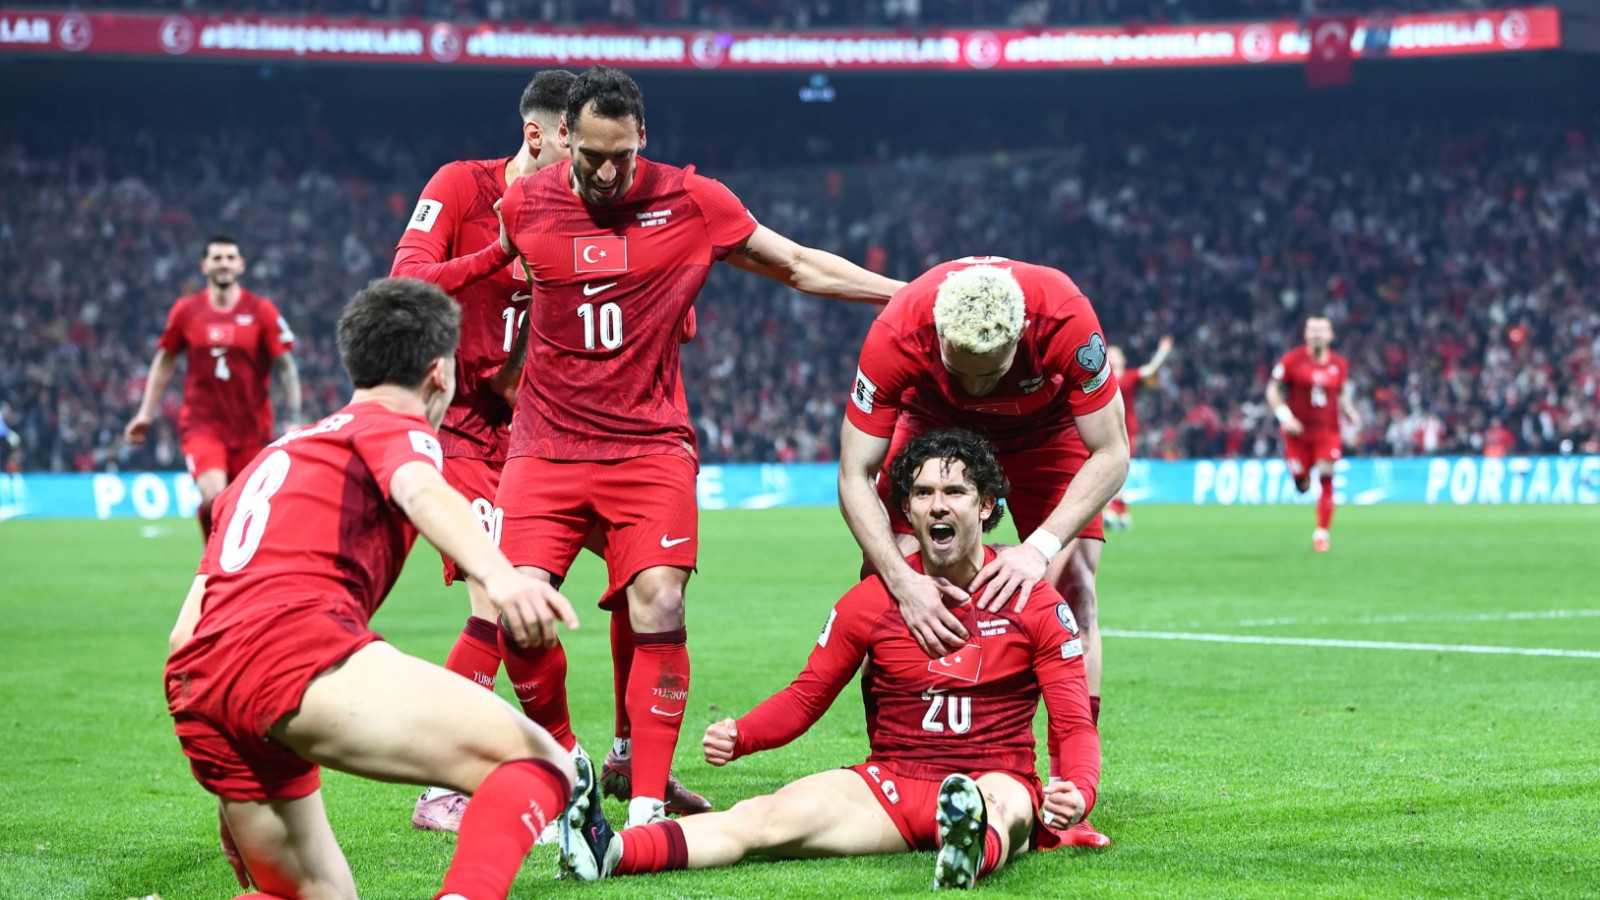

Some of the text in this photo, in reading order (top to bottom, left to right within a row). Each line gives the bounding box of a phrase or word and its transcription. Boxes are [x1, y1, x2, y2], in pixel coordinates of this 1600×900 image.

[577, 302, 623, 350] 10
[220, 450, 290, 573] 8
[921, 692, 972, 734] 20
